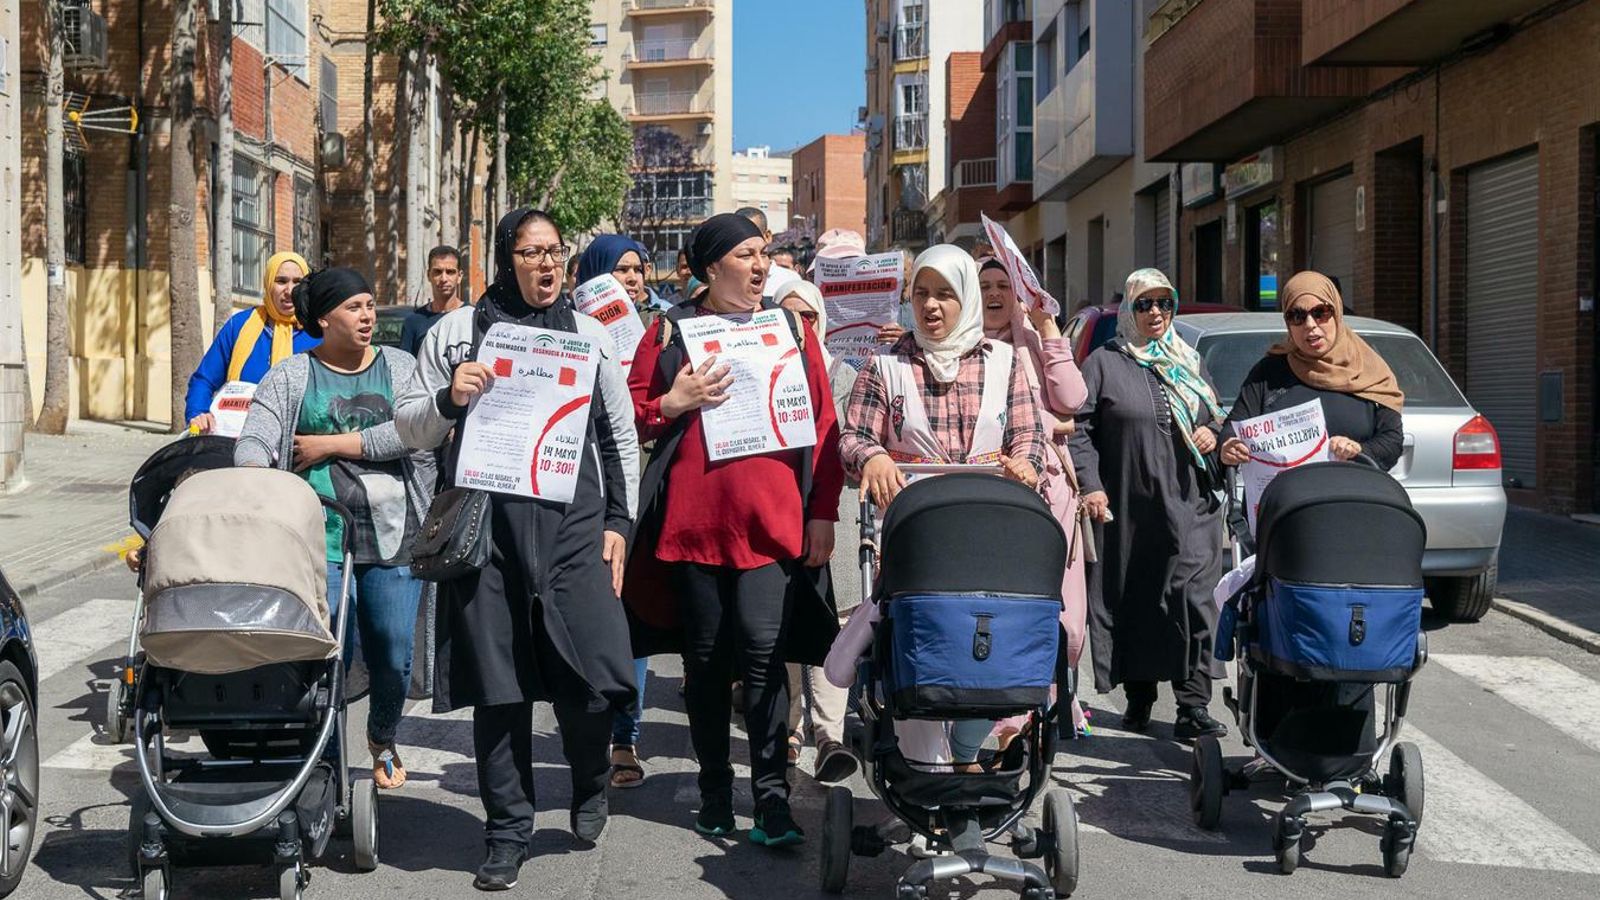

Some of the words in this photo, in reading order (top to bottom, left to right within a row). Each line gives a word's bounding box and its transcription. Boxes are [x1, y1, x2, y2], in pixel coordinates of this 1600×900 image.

[825, 281, 891, 294] MANIFESTACIÓN
[787, 396, 806, 407] MAYO
[778, 407, 809, 423] 10:30H
[1238, 420, 1275, 440] 10:30H
[1288, 425, 1319, 444] MARTES
[544, 445, 553, 456] 14
[555, 447, 577, 460] MAYO
[1250, 440, 1275, 452] MAYO
[540, 459, 575, 475] 10:30H
